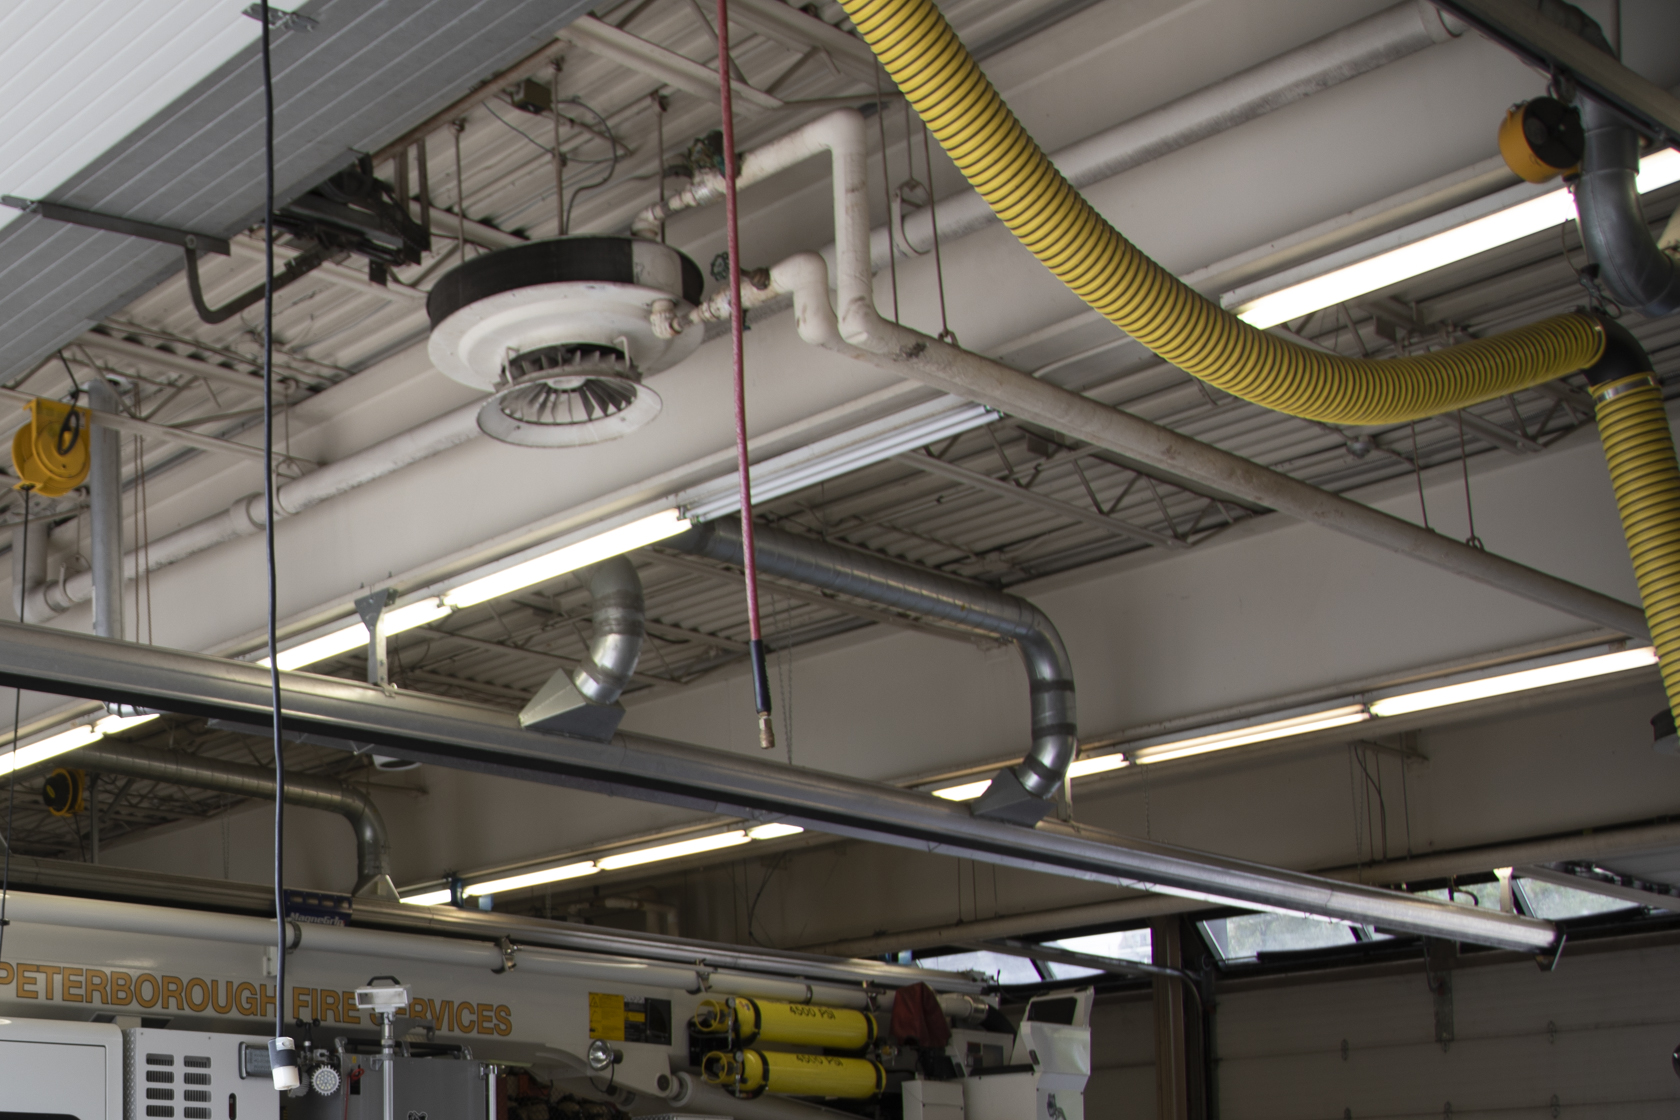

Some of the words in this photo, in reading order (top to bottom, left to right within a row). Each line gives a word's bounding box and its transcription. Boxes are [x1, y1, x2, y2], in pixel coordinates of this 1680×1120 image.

[290, 911, 345, 927] MagneGrip
[292, 986, 362, 1025] FIRE
[370, 995, 513, 1037] RVICES
[789, 1005, 816, 1017] 4500
[818, 1007, 836, 1020] PSI
